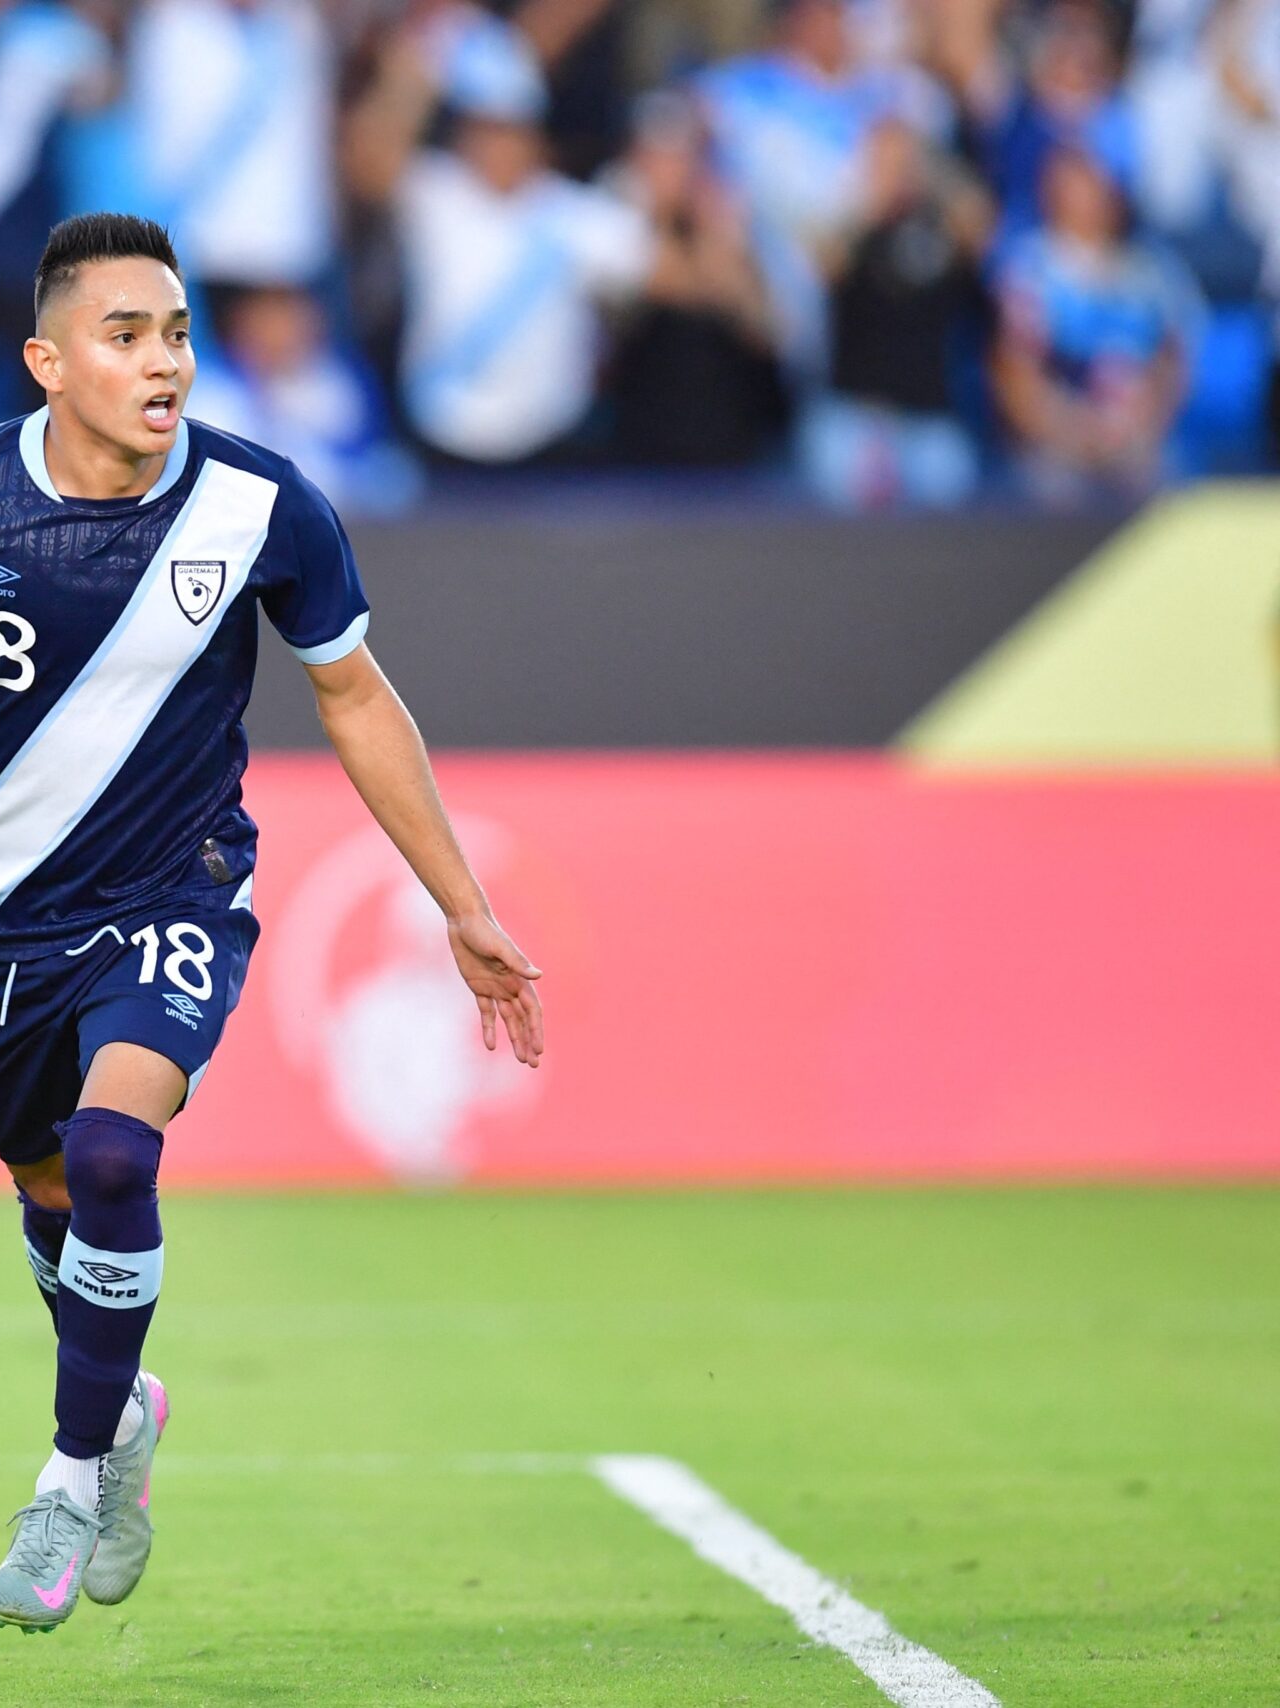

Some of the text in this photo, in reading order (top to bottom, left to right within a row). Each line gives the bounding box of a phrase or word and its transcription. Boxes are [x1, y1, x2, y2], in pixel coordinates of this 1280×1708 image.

[130, 922, 215, 1001] 18
[165, 1006, 198, 1031] umbro
[73, 1274, 139, 1298] umbro
